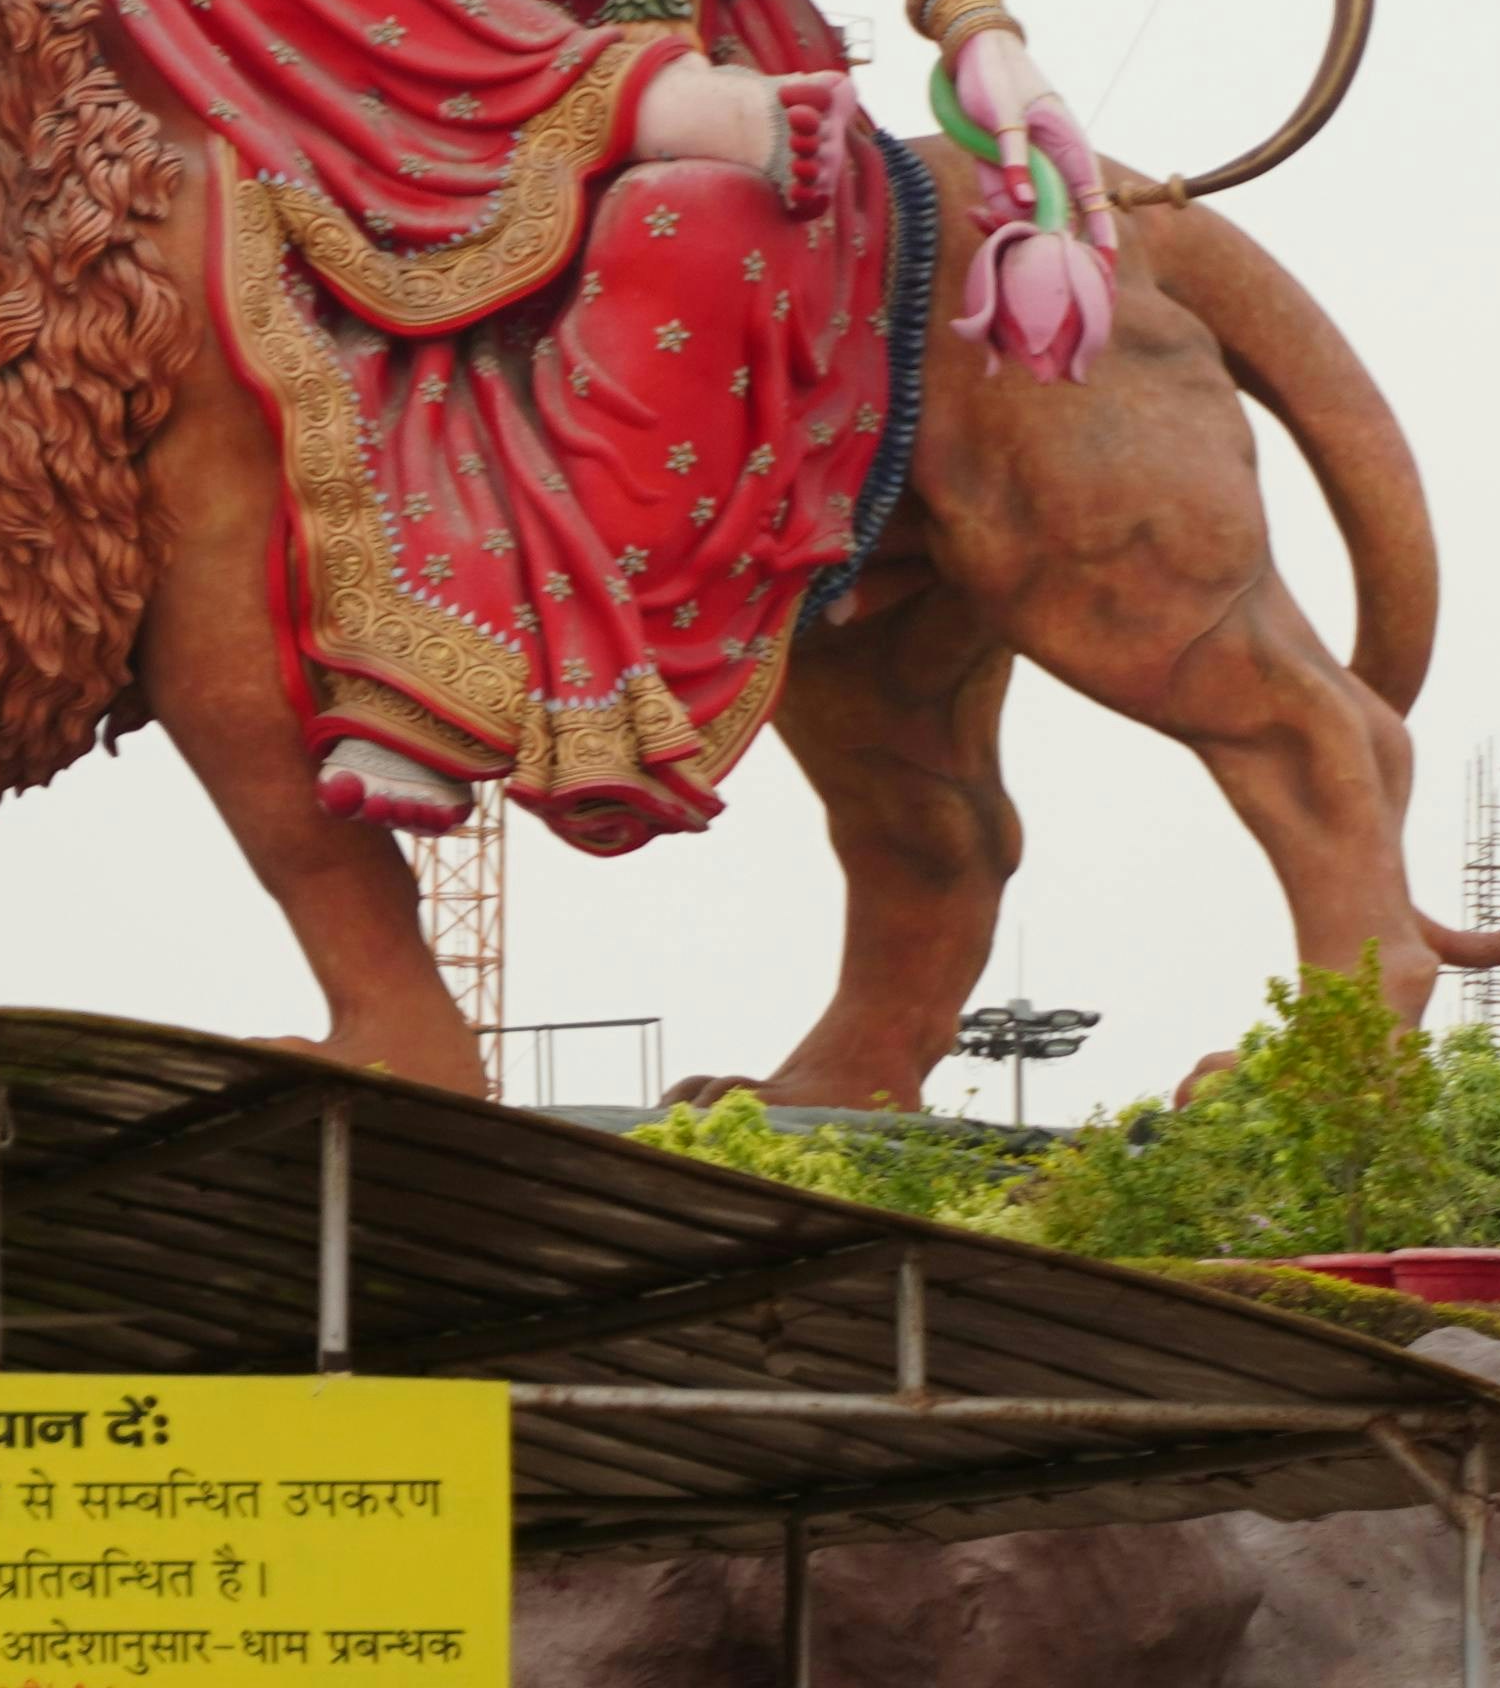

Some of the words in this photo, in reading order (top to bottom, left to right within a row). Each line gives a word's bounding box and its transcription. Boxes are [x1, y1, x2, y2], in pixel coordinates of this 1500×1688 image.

[17, 1468, 56, 1520] से
[73, 1467, 262, 1519] सम्बन्धित
[277, 1479, 442, 1518] उपकरण
[323, 1629, 466, 1666] प्रबन्धक
